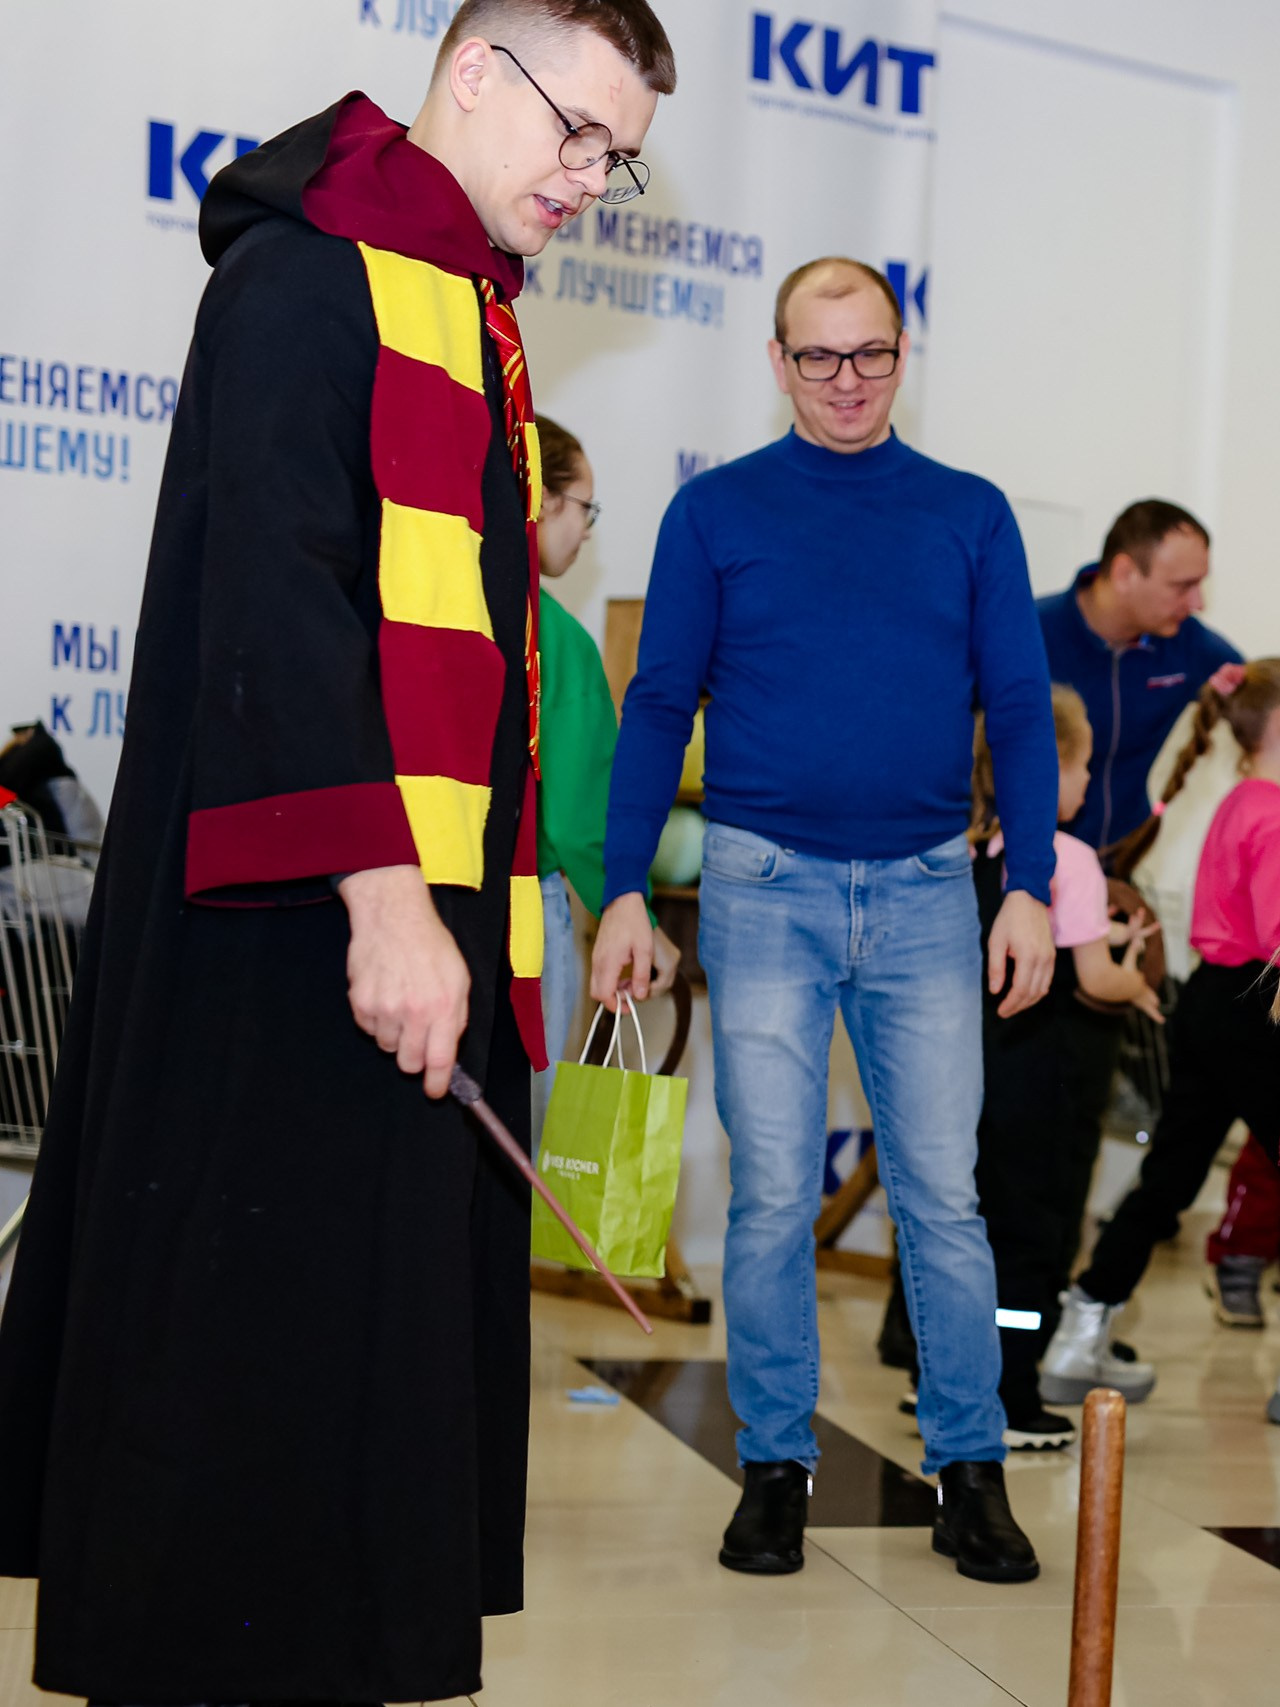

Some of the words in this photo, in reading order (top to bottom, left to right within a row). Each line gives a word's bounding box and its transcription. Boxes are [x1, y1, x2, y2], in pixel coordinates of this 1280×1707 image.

[752, 13, 936, 114] КИТ
[148, 120, 261, 203] К
[595, 207, 764, 279] МЕНЯЕМСЯ
[52, 622, 119, 674] МЫ
[52, 694, 73, 733] К
